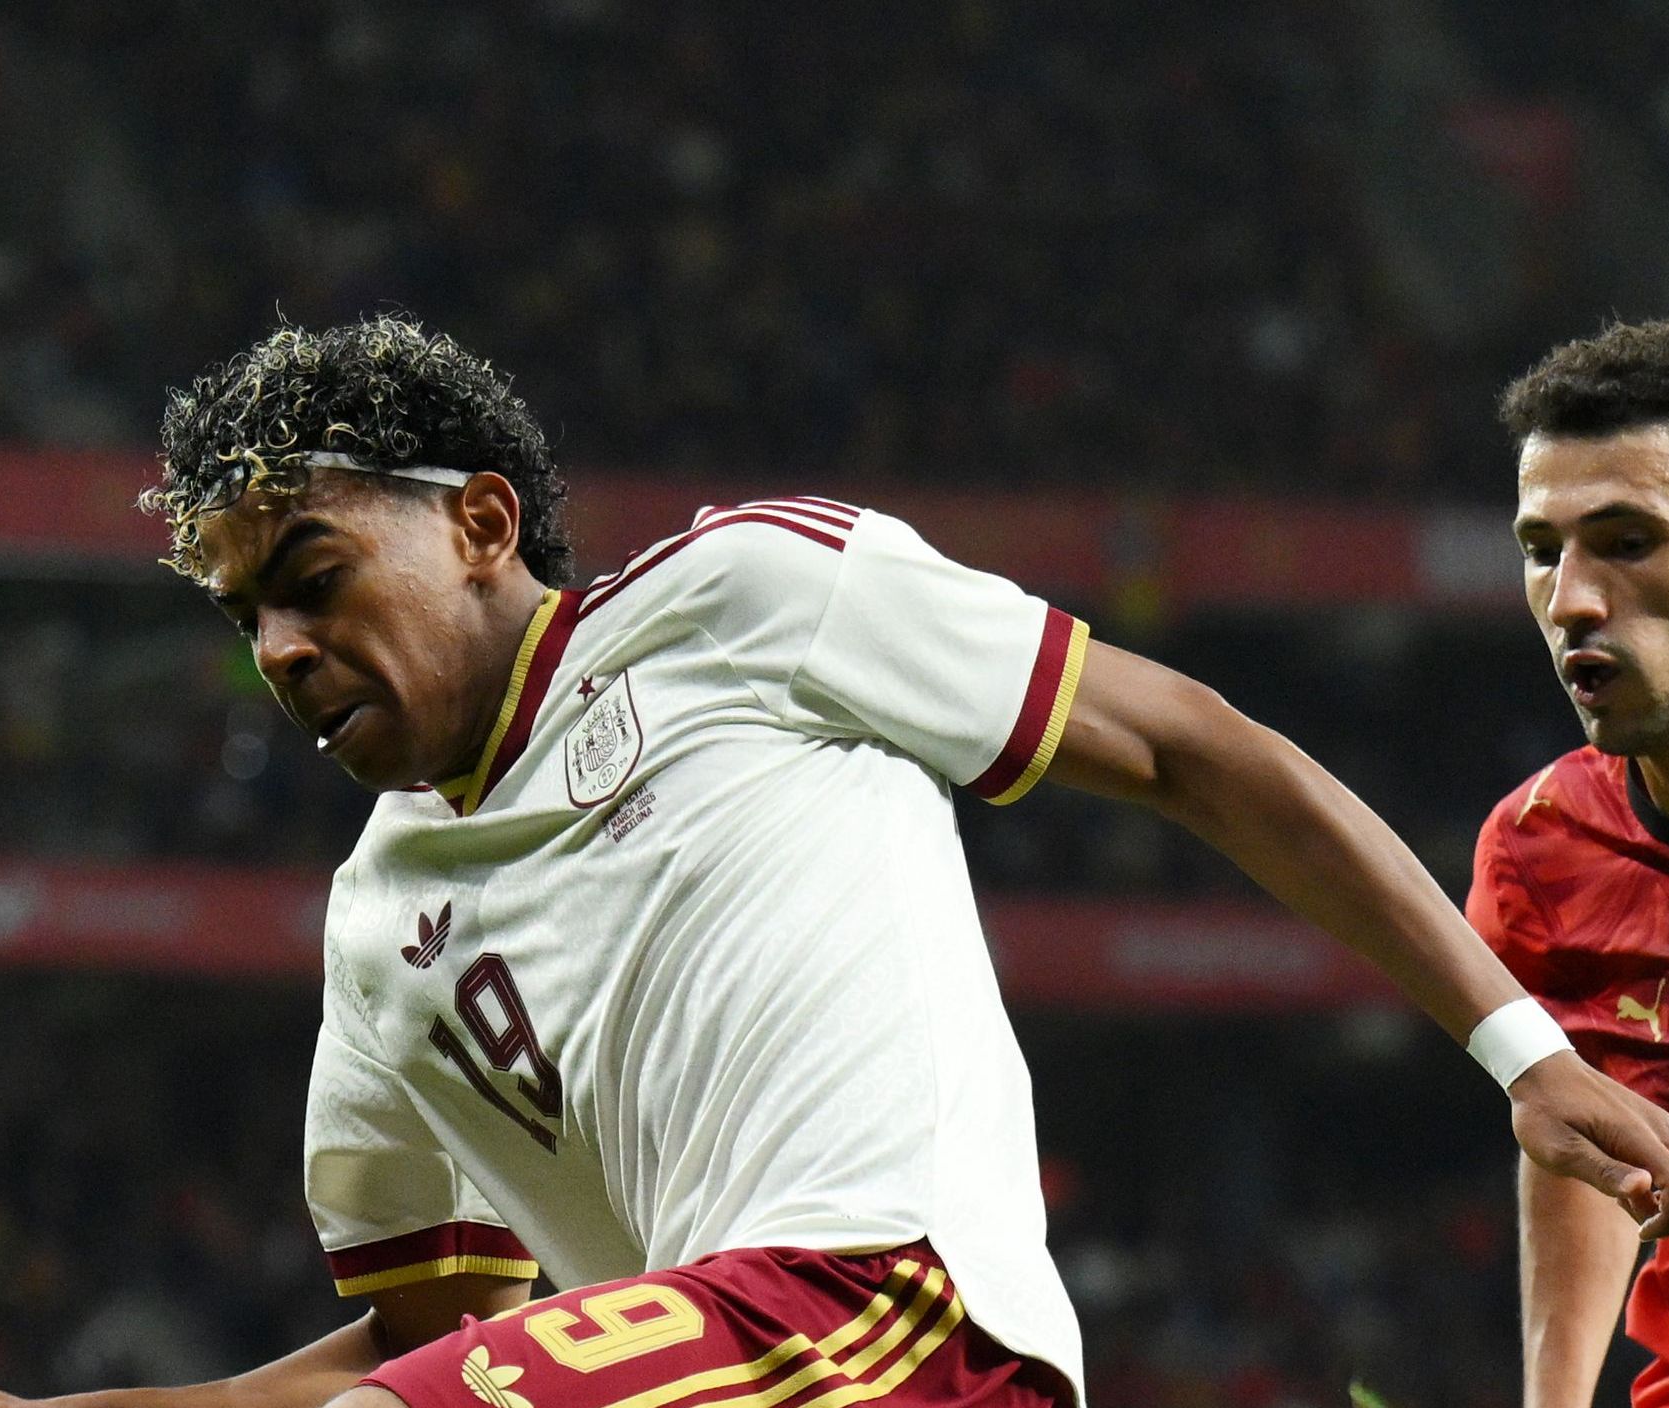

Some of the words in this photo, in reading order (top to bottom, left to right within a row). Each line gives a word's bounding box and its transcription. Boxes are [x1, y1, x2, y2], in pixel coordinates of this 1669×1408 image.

[611, 804, 636, 831] MARCH
[635, 791, 657, 811] 2026
[612, 806, 654, 844] BARCELONA
[428, 952, 563, 1155] 19
[489, 1279, 705, 1373] 9
